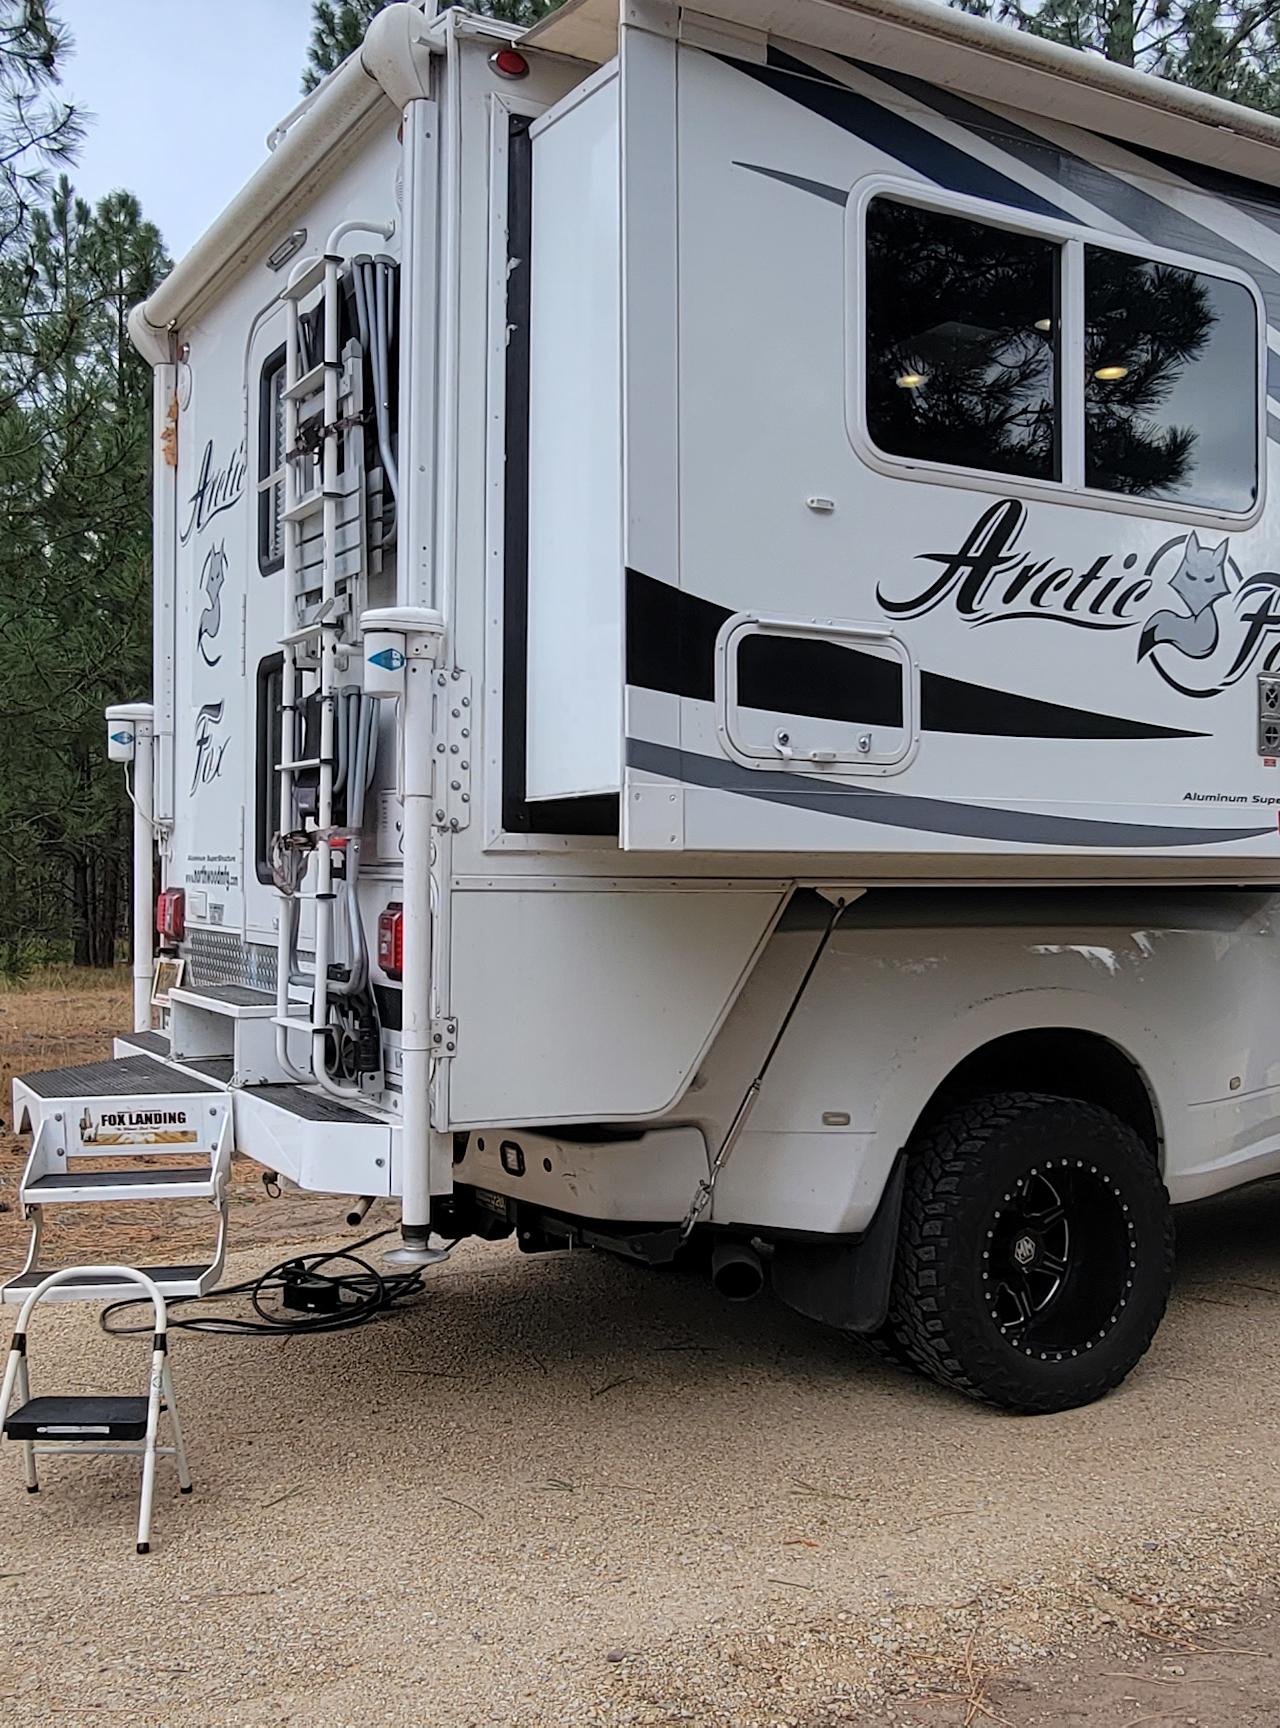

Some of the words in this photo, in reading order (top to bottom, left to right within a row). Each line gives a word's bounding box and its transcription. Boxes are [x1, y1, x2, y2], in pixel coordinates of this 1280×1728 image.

[876, 498, 1153, 629] Arctic
[189, 698, 231, 797] Fox
[1183, 792, 1248, 803] Aluminum
[101, 1113, 126, 1127] FOX
[128, 1111, 187, 1126] LANDING
